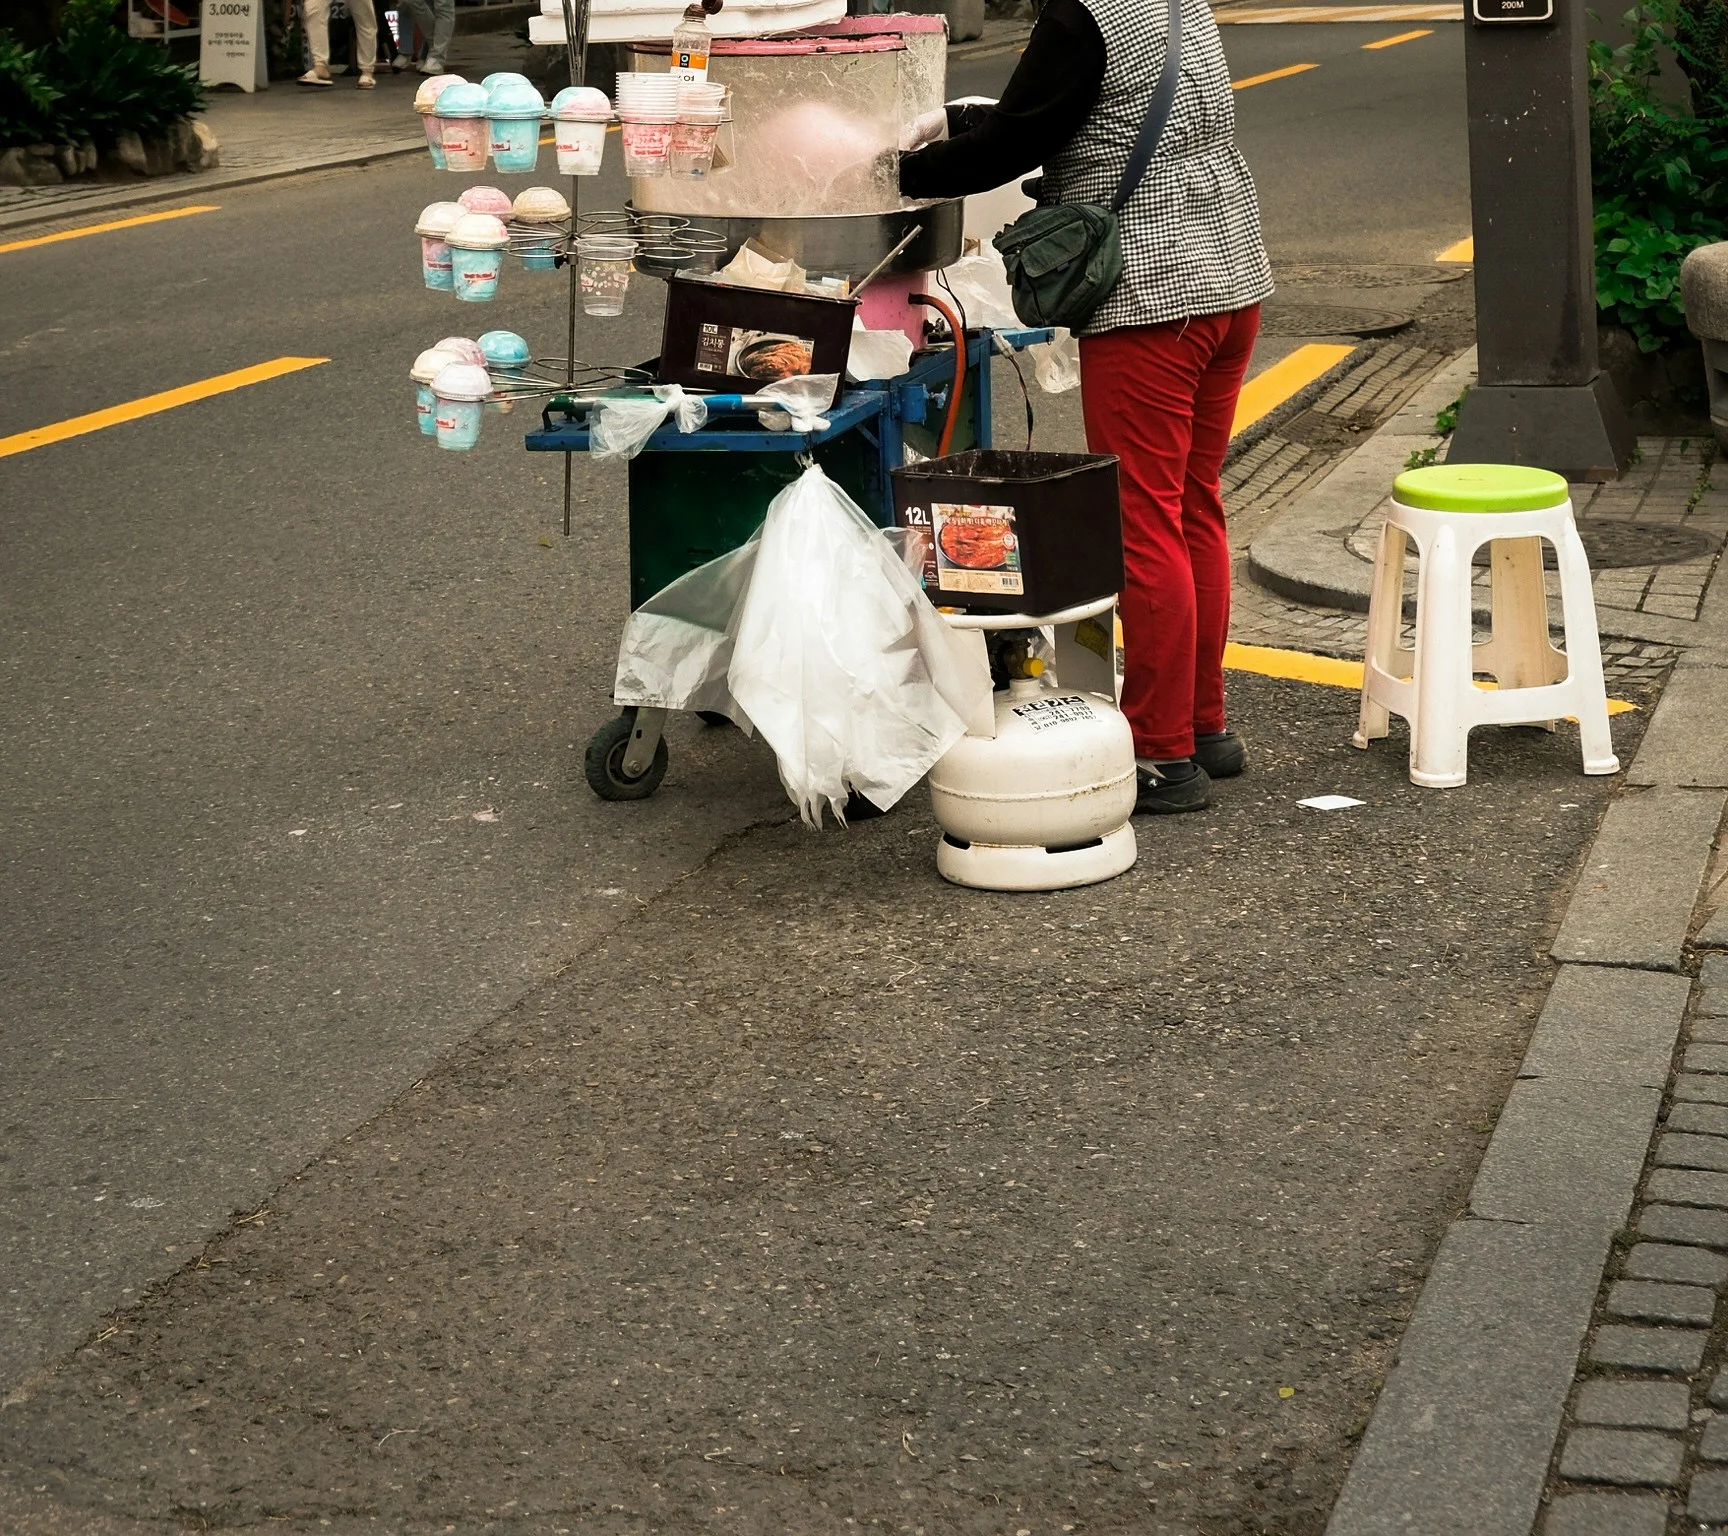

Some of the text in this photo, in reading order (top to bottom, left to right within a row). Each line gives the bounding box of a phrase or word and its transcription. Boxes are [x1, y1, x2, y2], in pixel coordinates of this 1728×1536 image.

[1501, 0, 1524, 9] 200M
[701, 336, 725, 349] 김치통
[905, 506, 931, 525] 12L
